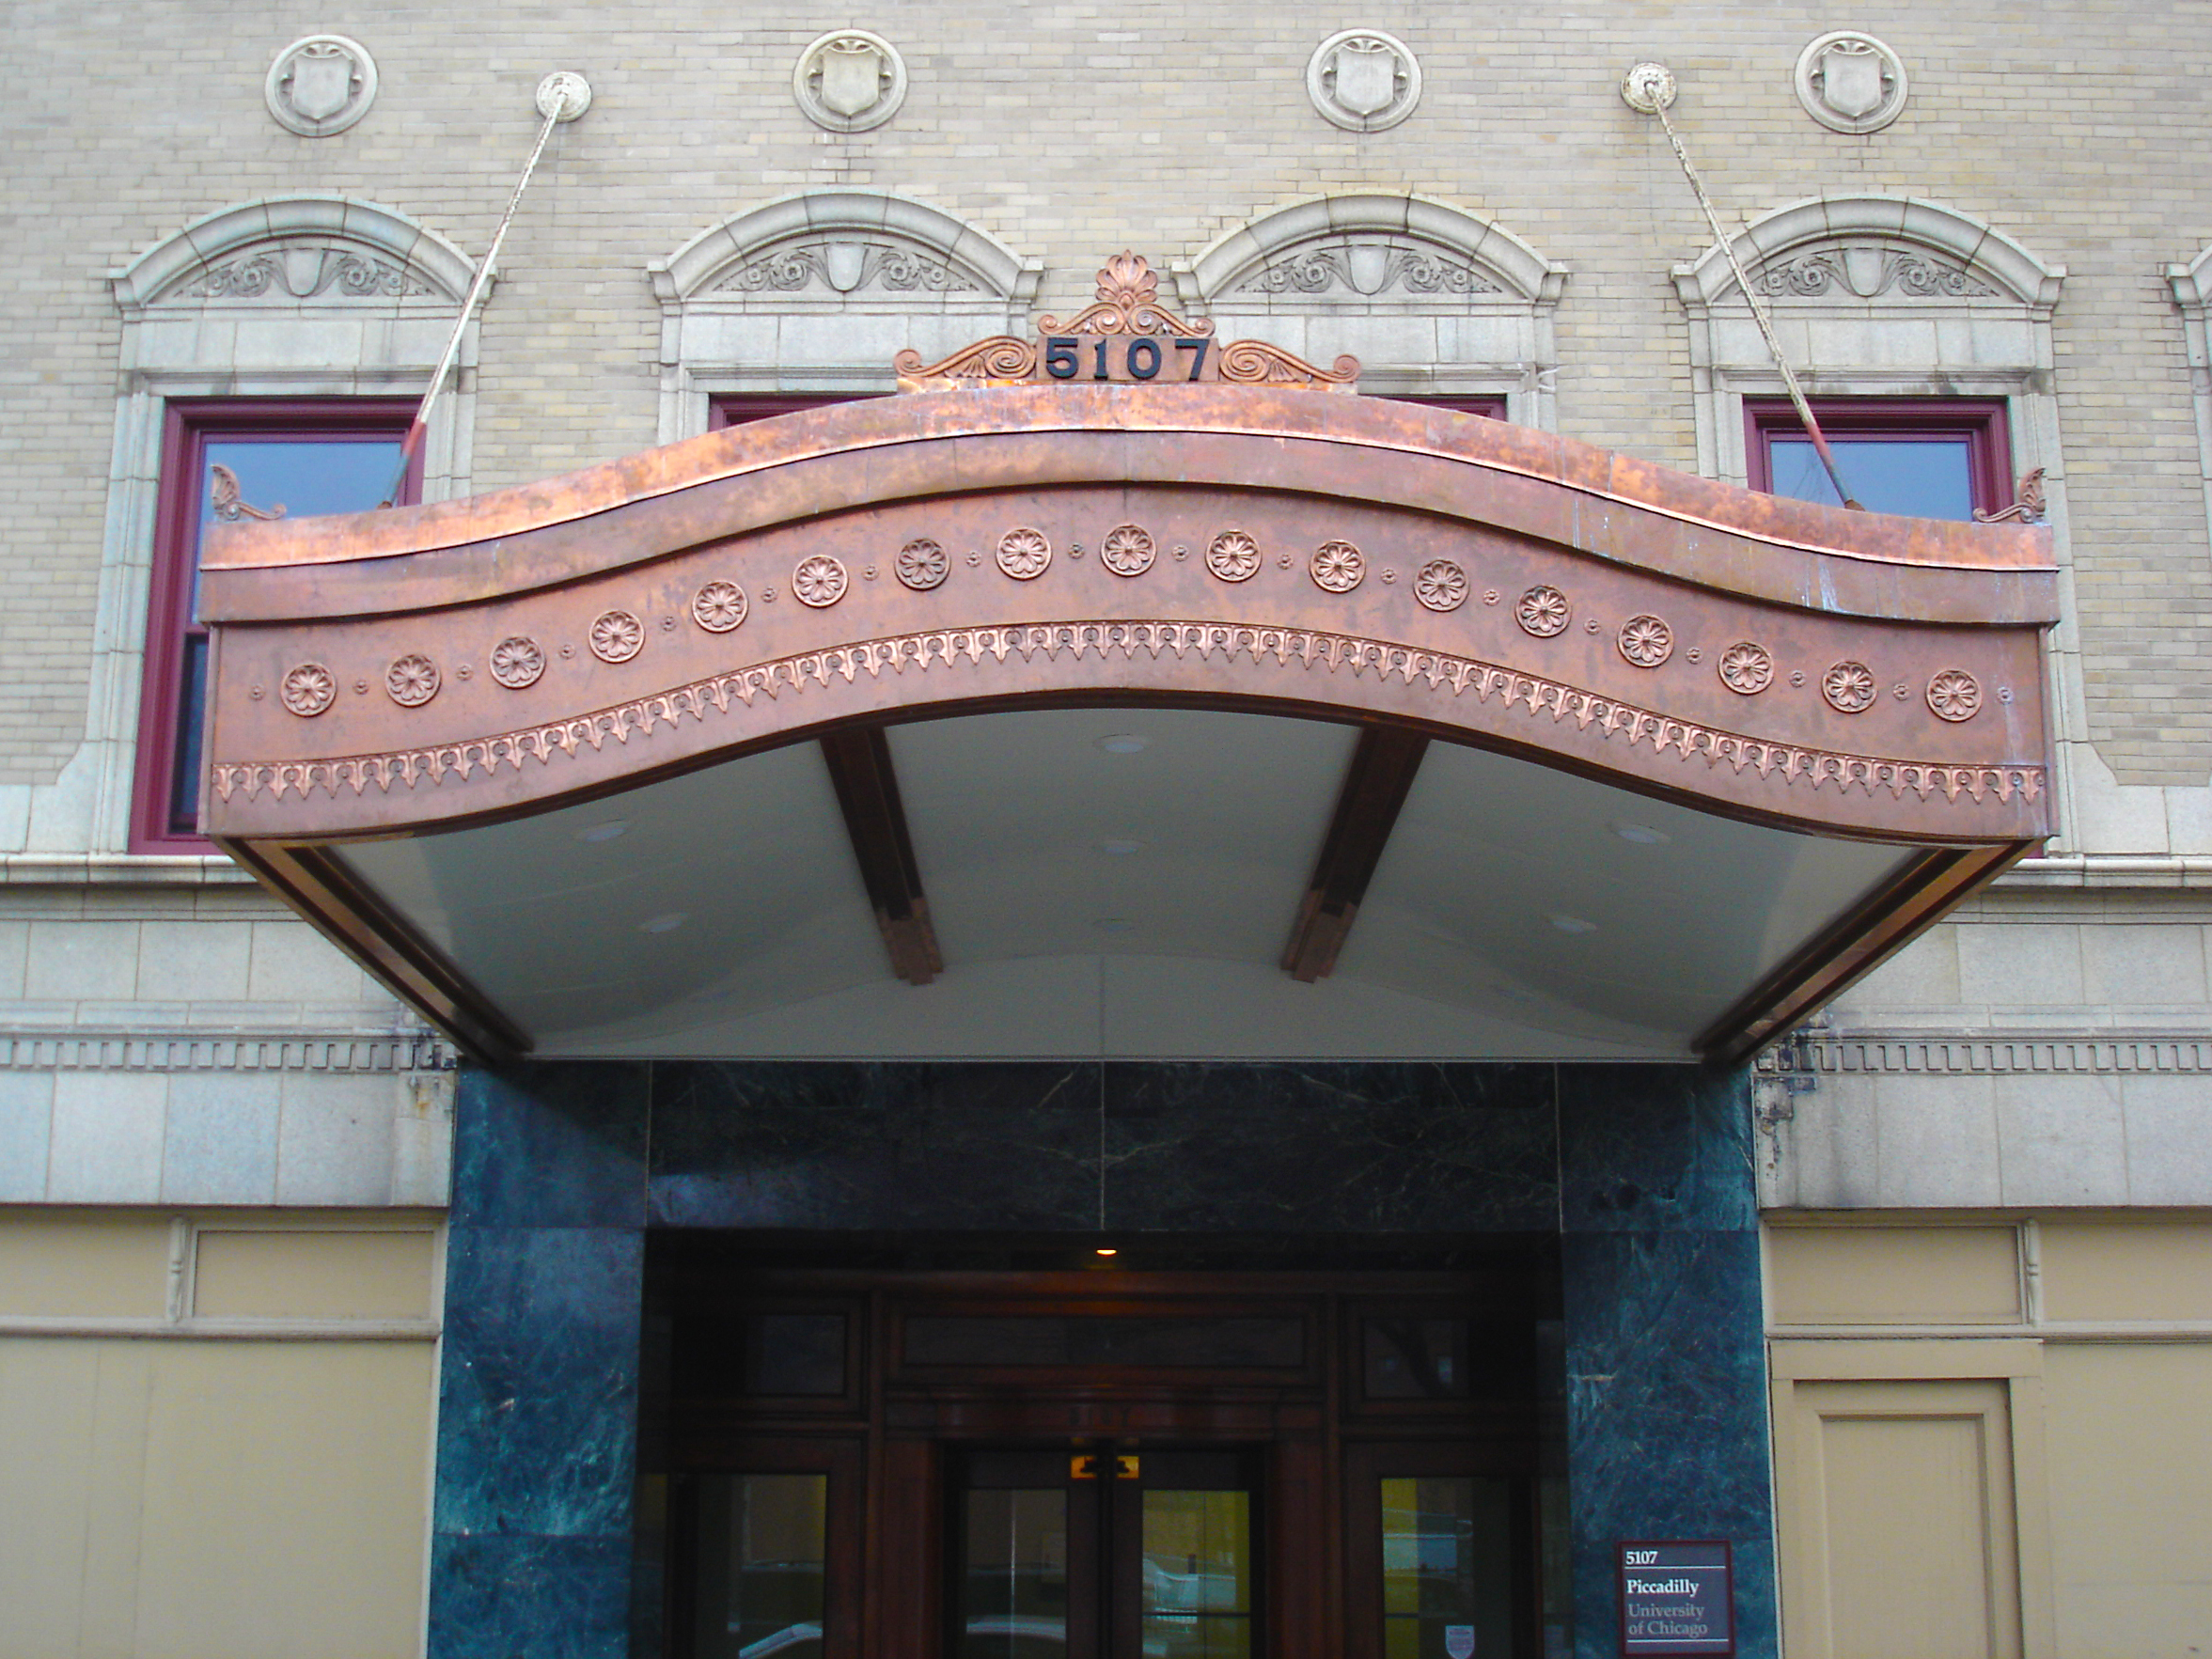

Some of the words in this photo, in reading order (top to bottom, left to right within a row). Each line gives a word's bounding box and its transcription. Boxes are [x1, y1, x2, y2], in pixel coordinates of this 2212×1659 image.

[1046, 337, 1210, 381] 5107
[1625, 1551, 1658, 1565] 5107
[1627, 1579, 1700, 1597] Piccadilly
[1627, 1604, 1704, 1620] University
[1628, 1620, 1644, 1635] of
[1647, 1620, 1708, 1638] Chicago
